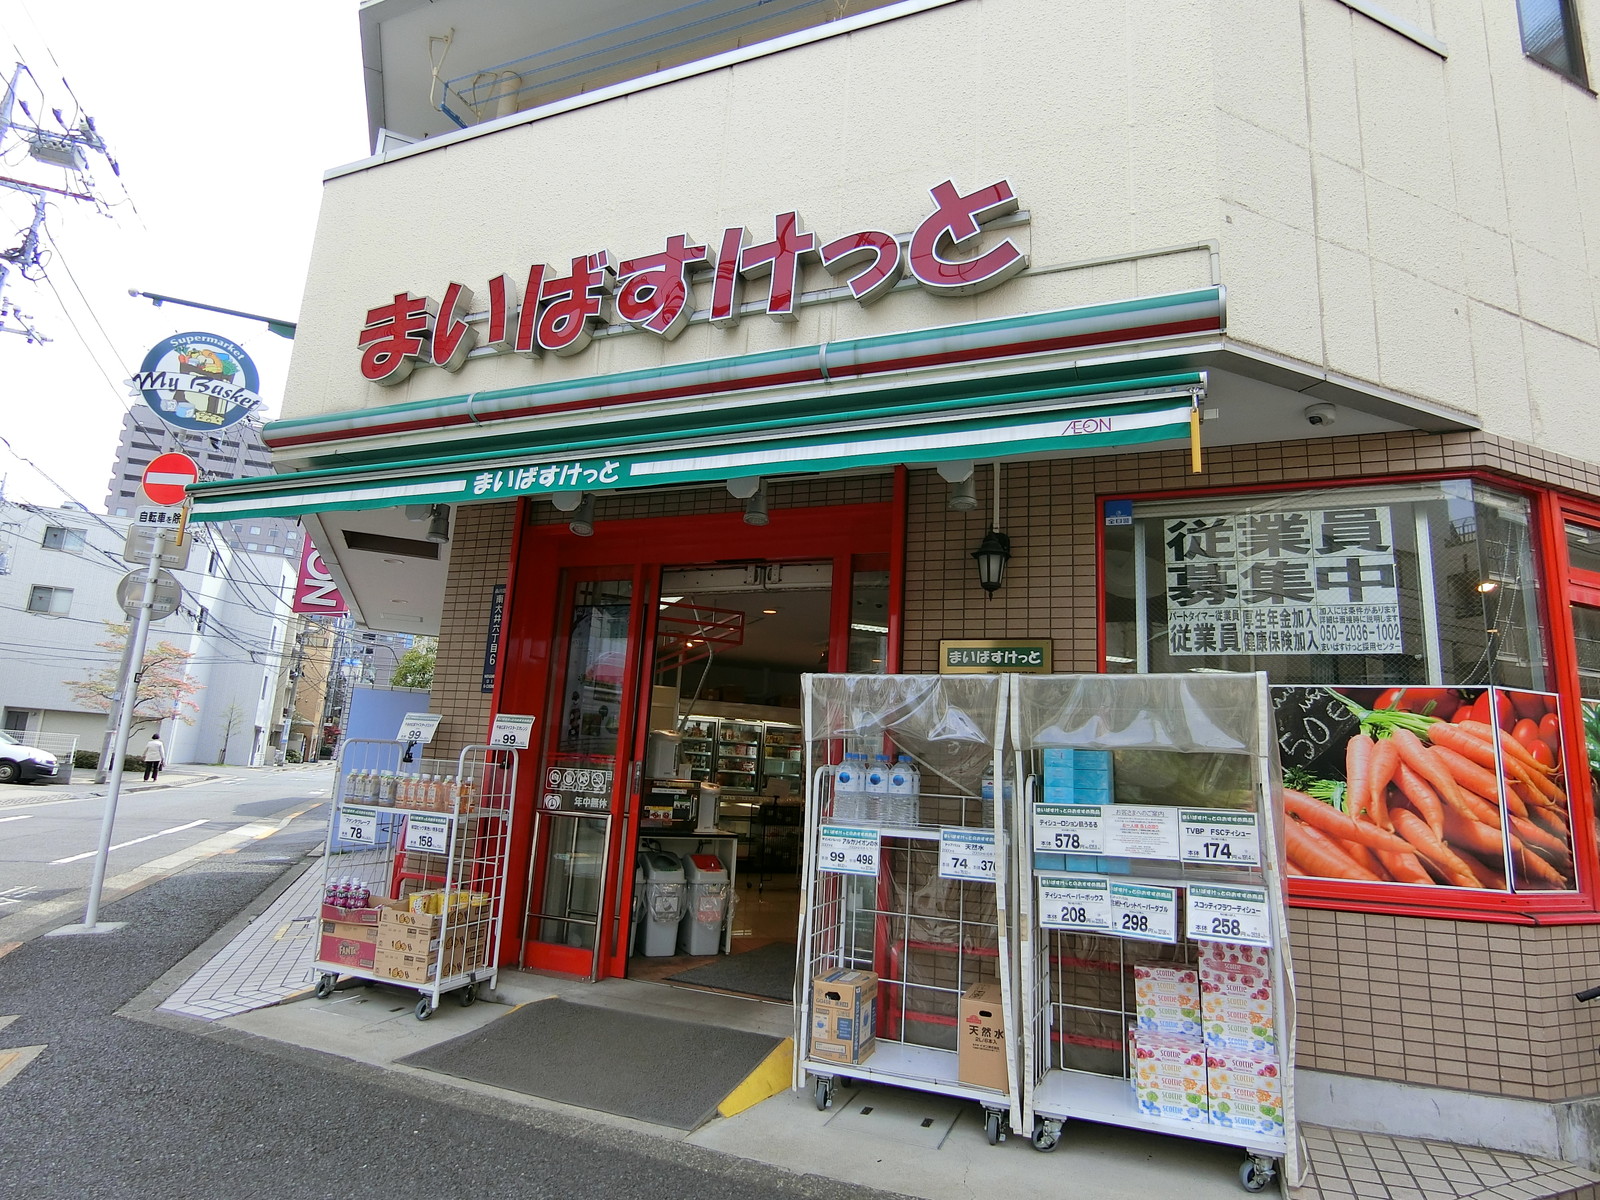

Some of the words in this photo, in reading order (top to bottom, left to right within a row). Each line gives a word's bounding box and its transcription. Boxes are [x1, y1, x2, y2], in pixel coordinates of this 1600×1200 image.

[358, 179, 1022, 386] まいばすけっと
[169, 335, 245, 360] Supermarket
[132, 371, 179, 392] My
[190, 377, 260, 411] Basket
[473, 461, 620, 495] まいばすけっと
[139, 511, 182, 524] 自転車を除
[1167, 509, 1391, 561] 従業員
[1168, 558, 1395, 607] 募集中
[1169, 610, 1240, 621] パートタイマー従業員
[1320, 606, 1397, 615] 加入には条件があります
[1243, 608, 1317, 630] 厚生年金加入
[1320, 615, 1398, 624] 詳細は面接時に説明します
[1170, 623, 1241, 652] 従業員
[1320, 624, 1400, 641] 050-2036-1002
[1244, 630, 1319, 652] 健康保険加入
[1321, 642, 1400, 651] まいばすけっと採用センター
[949, 650, 1041, 664] まいばすけっと
[408, 730, 421, 739] 99
[502, 734, 516, 744] 99
[574, 796, 608, 809] 年中無休
[350, 826, 362, 839] 78
[1185, 827, 1205, 835] TVBP
[1210, 828, 1252, 837] FSCティシュー
[418, 835, 433, 848] 158
[965, 843, 985, 851] 天然水
[1055, 833, 1080, 849] 578
[830, 851, 845, 863] 99
[1203, 842, 1232, 859] 174
[856, 854, 873, 865] 498
[951, 857, 968, 869] 74
[1061, 906, 1087, 923] 208
[1194, 901, 1261, 914] スコッティフラワーティシュー
[1122, 913, 1148, 932] 298
[1212, 917, 1241, 936] 258
[969, 1025, 1004, 1039] 天然水
